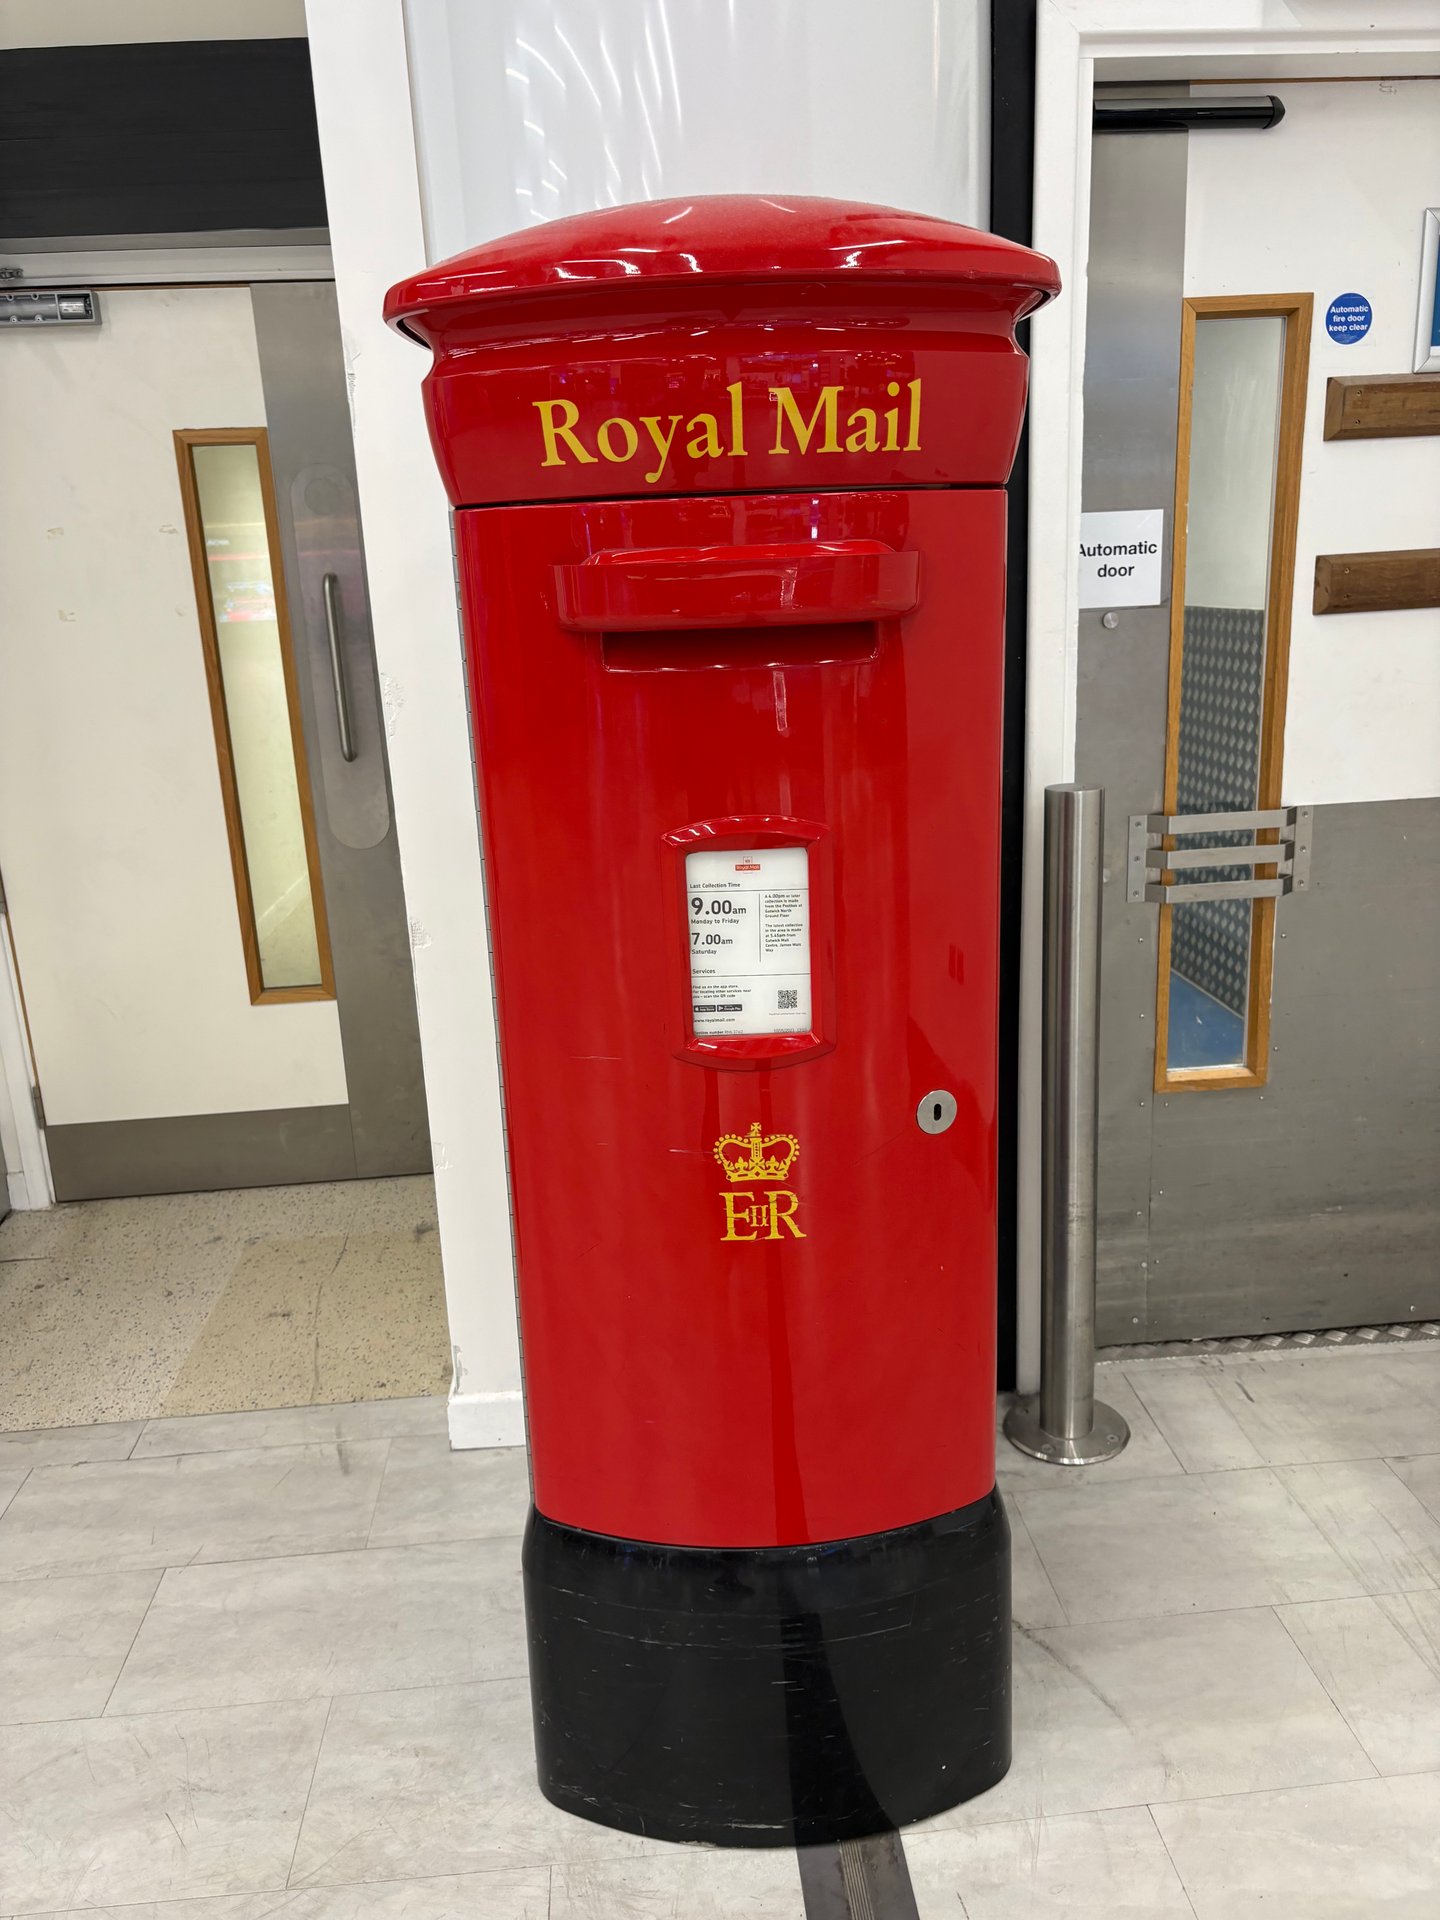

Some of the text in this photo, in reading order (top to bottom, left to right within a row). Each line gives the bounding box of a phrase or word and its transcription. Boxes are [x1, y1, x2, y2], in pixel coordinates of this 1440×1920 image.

[1330, 305, 1369, 313] Automatic
[531, 378, 922, 484] Royal Mail
[1097, 564, 1135, 578] door
[691, 897, 747, 915] 9.00am
[691, 933, 733, 945] 7.00am
